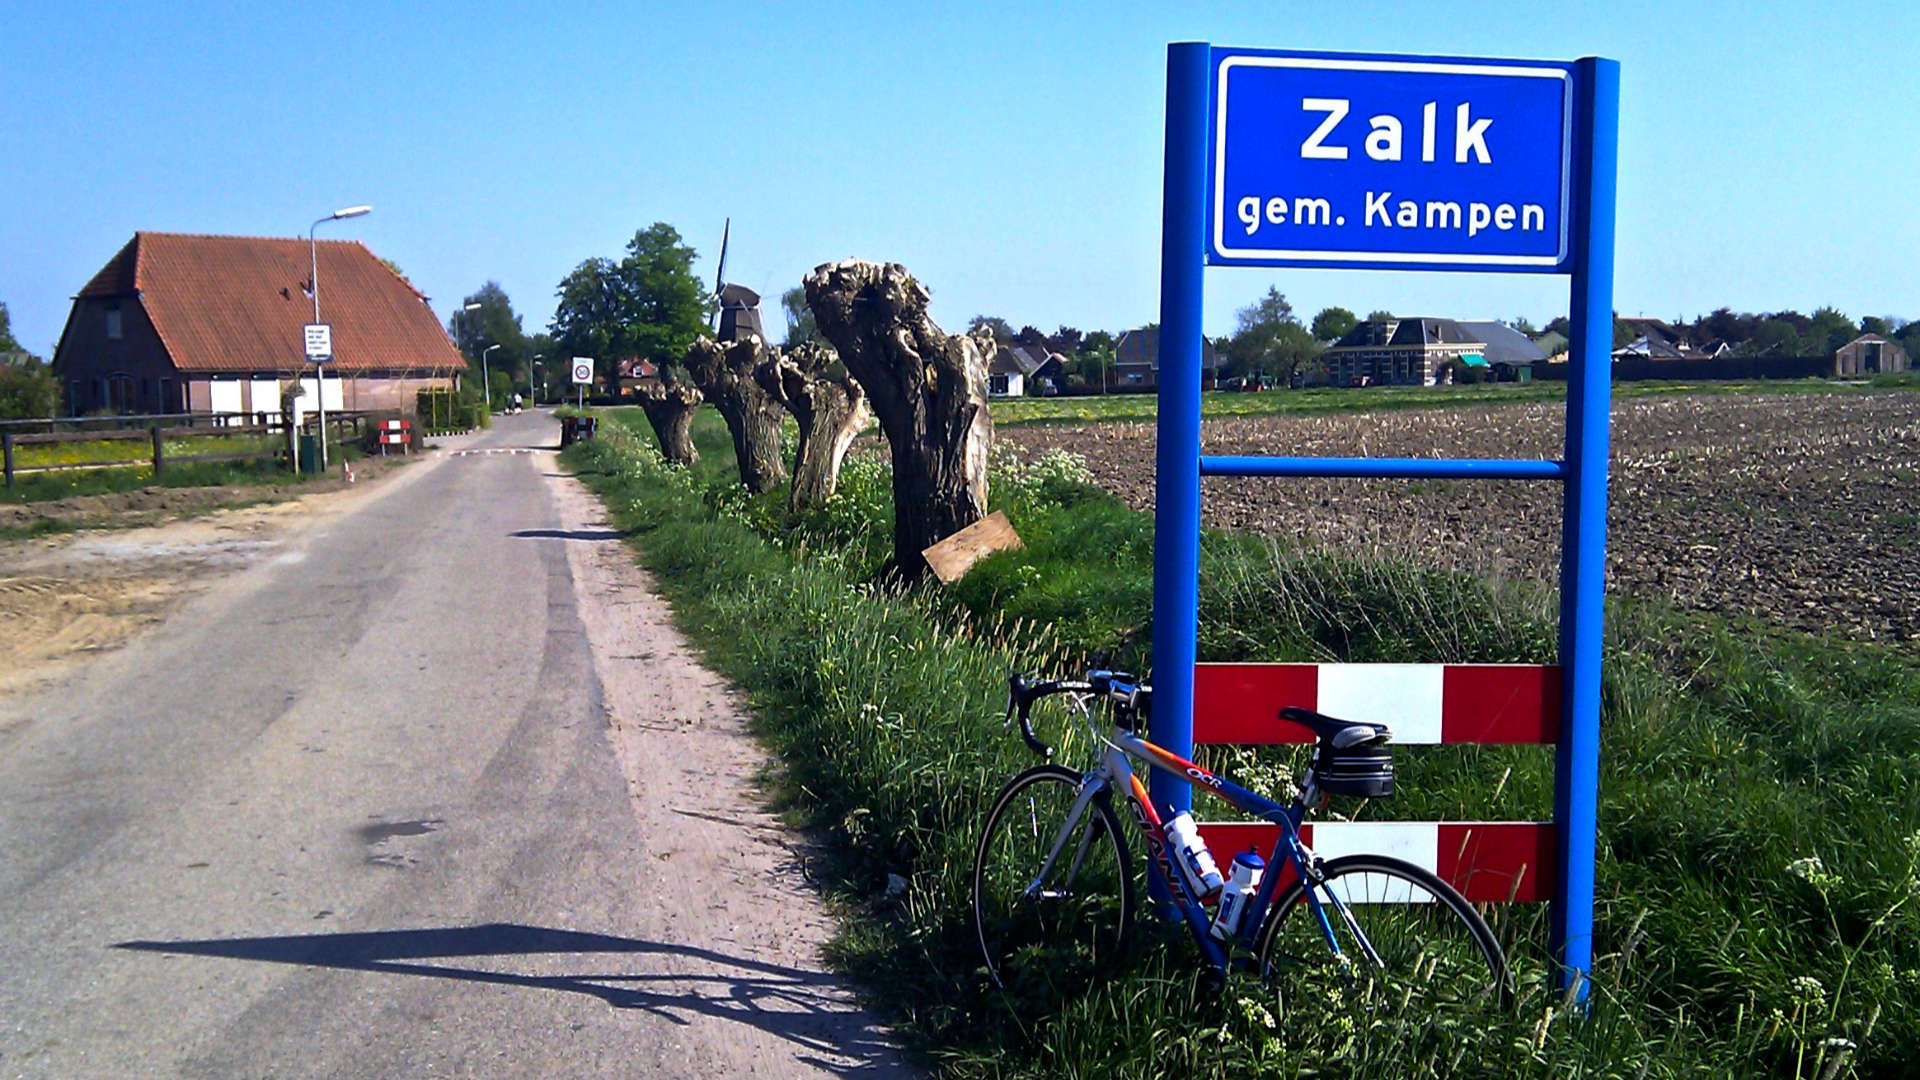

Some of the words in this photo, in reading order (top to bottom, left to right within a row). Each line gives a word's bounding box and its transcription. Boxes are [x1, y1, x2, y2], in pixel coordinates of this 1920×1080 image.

[1300, 98, 1493, 164] Zalk
[1237, 196, 1345, 236] gem.
[1364, 191, 1544, 237] Kampen
[1186, 767, 1223, 789] OCR
[1128, 796, 1195, 907] GIANT
